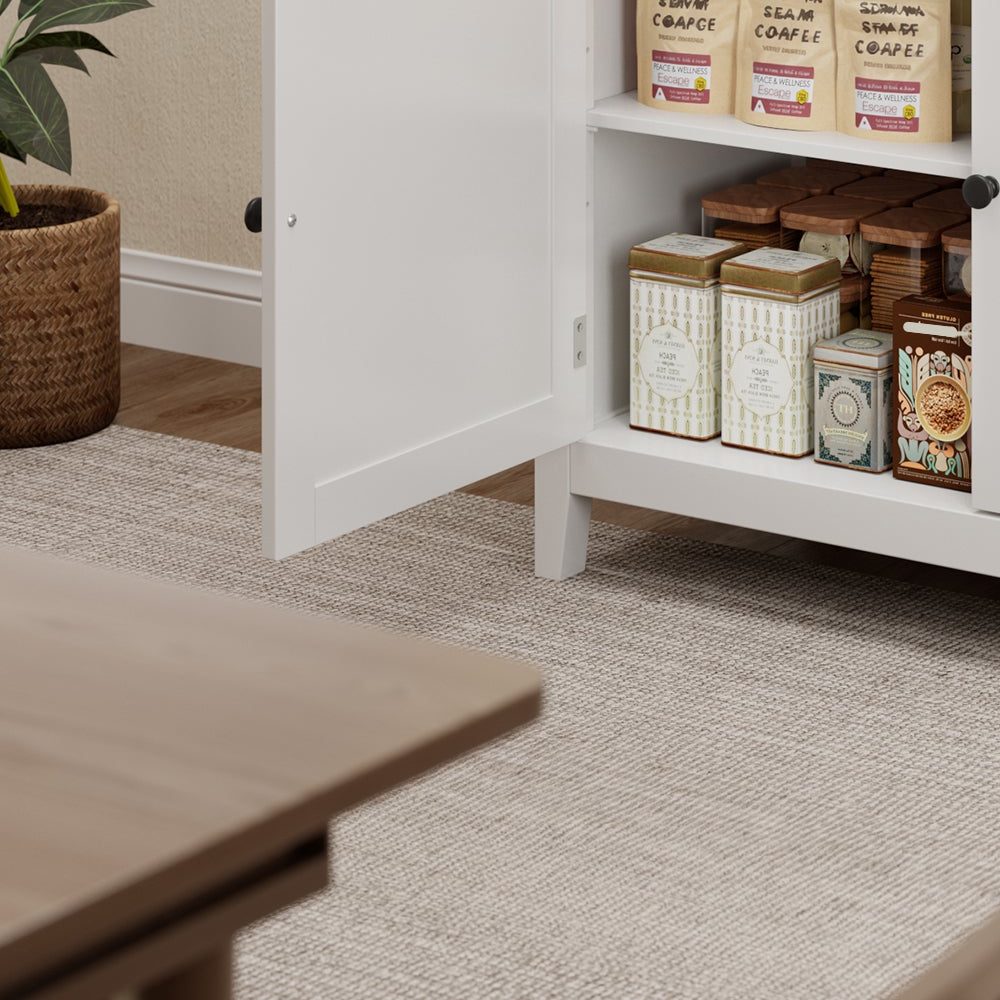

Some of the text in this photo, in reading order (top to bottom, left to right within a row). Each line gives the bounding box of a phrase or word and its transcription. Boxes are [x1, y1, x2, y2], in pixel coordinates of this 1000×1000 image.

[653, 62, 671, 73] PEACE
[677, 66, 709, 75] WELLNESS
[657, 72, 690, 86] Escape
[753, 74, 773, 85] PEACE
[778, 78, 811, 88] WELLNESS
[757, 84, 791, 98] Escape
[856, 90, 877, 101] PEACE
[884, 94, 918, 103] WELLNESS
[862, 100, 898, 115] Escape
